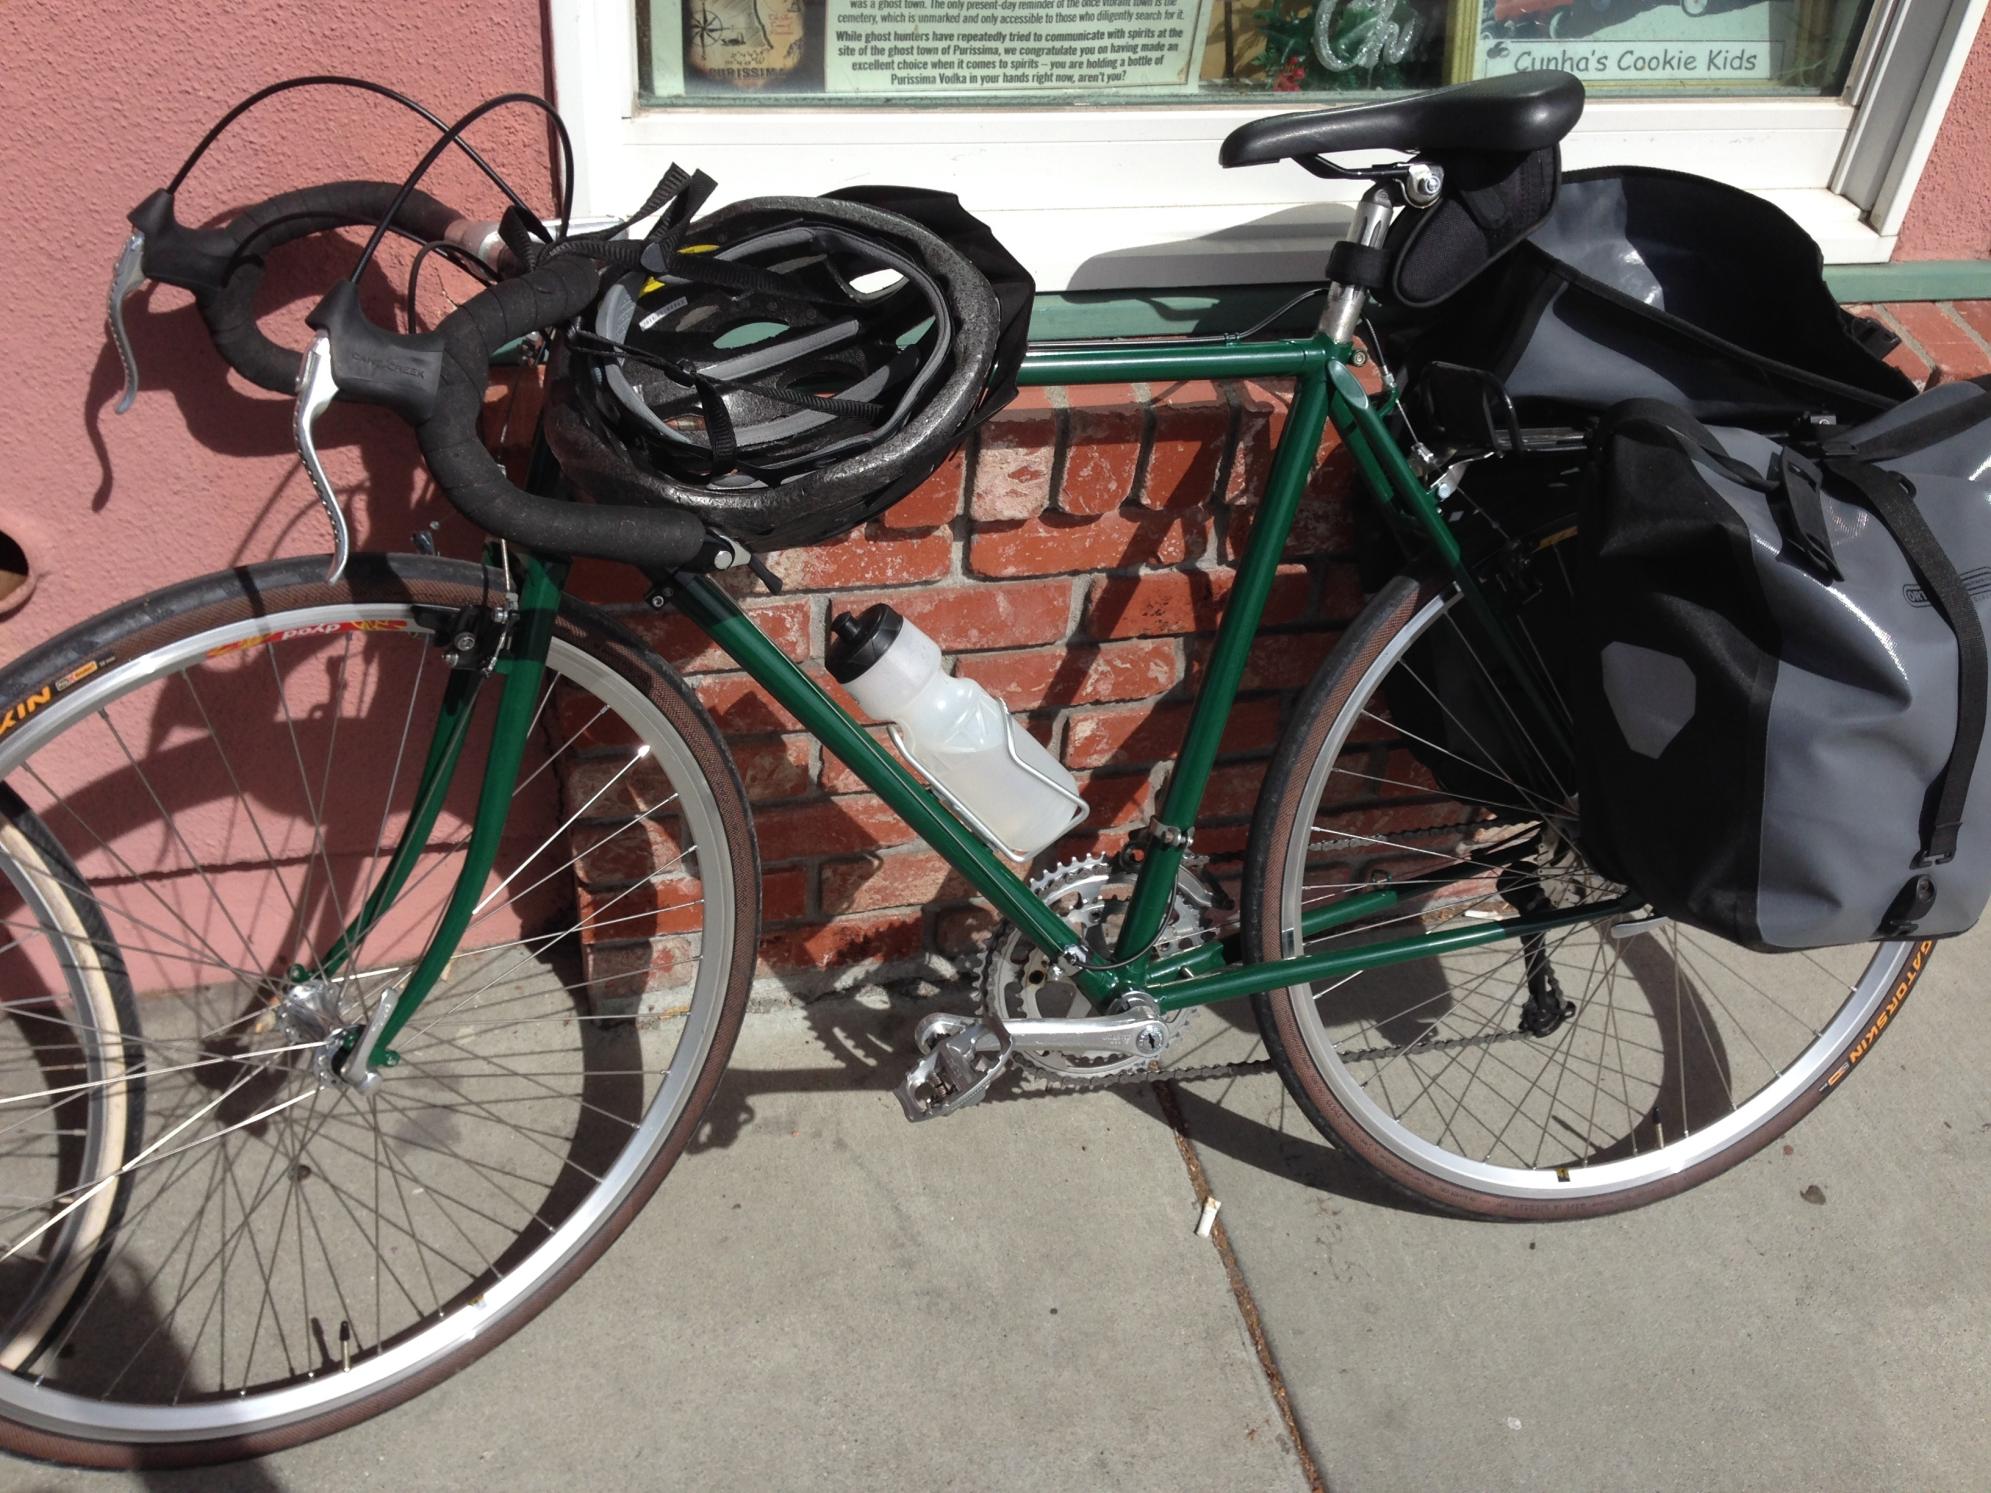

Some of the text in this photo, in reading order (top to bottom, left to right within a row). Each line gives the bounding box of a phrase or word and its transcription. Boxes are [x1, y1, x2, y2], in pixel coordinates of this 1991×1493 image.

[850, 0, 867, 9] was
[878, 0, 901, 10] ghost
[904, 0, 927, 9] town.
[930, 0, 945, 9] The
[947, 0, 964, 11] only
[966, 0, 1016, 11] present-day
[1018, 0, 1054, 9] reminder
[1056, 0, 1065, 8] of
[1067, 0, 1079, 8] the
[1081, 0, 1099, 8] once
[837, 9, 1184, 25] cemetery, which is unmarked and only accessible to those who diligently search for it.
[836, 27, 1183, 44] While ghost hunters have repeatedly tried to communicate with spirits at the
[838, 46, 855, 56] site
[858, 46, 868, 56] of
[870, 45, 886, 56] the
[888, 45, 914, 58] ghost
[916, 46, 939, 56] town
[941, 45, 951, 55] of
[953, 44, 1001, 56] Purissima,
[1004, 48, 1017, 56] we
[1019, 45, 1077, 57] congratulate
[1079, 47, 1096, 58] you
[1110, 43, 1139, 55] having
[1141, 42, 1165, 52] made
[1167, 43, 1179, 52] an
[852, 60, 895, 71] excellent
[897, 59, 928, 70] choice
[931, 59, 955, 70] when
[957, 59, 964, 69] it
[966, 60, 996, 70] comes
[999, 59, 1008, 69] to
[1010, 58, 1039, 71] spirits
[1050, 60, 1066, 71] you
[1068, 60, 1084, 69] are
[1086, 57, 1118, 70] holding
[1119, 59, 1125, 67] a
[1128, 55, 1152, 67] bottle
[1154, 54, 1165, 65] of
[1513, 48, 1757, 73] Cunha's Cookie Kids
[891, 71, 1127, 87] Purissima Vodka in your hands right now, aren't you?
[1849, 940, 1932, 1063] GATORSKIN
